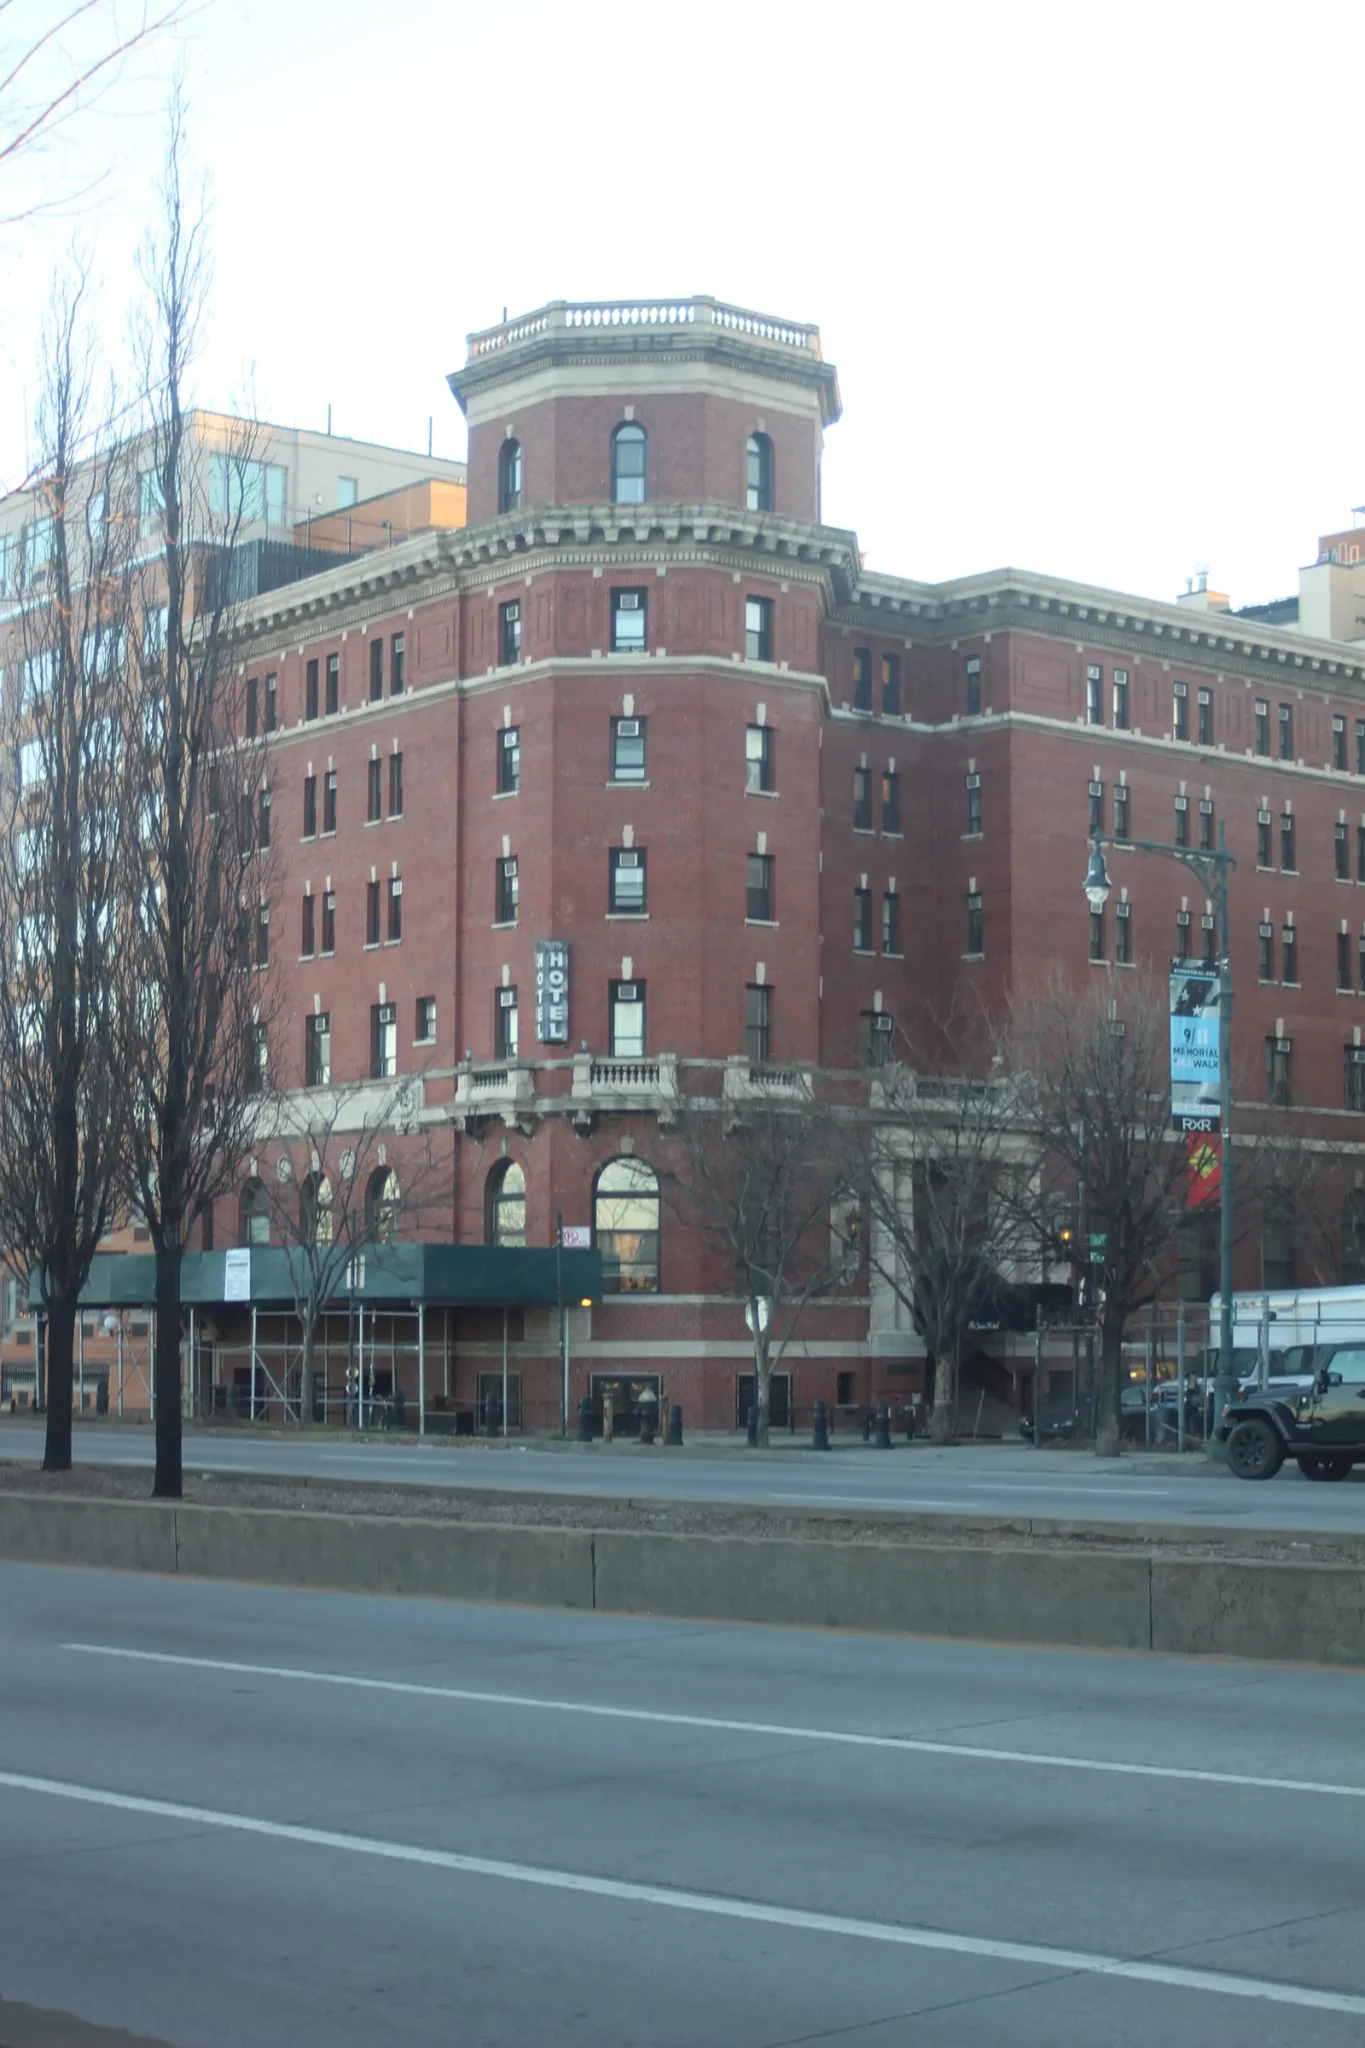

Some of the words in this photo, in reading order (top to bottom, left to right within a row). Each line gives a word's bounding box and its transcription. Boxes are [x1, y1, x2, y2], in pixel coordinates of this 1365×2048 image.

[549, 952, 563, 1038] HOTEL
[1184, 1028, 1208, 1045] 9/11
[1173, 1047, 1219, 1058] MEMORIAL
[1182, 1117, 1211, 1132] RXR
